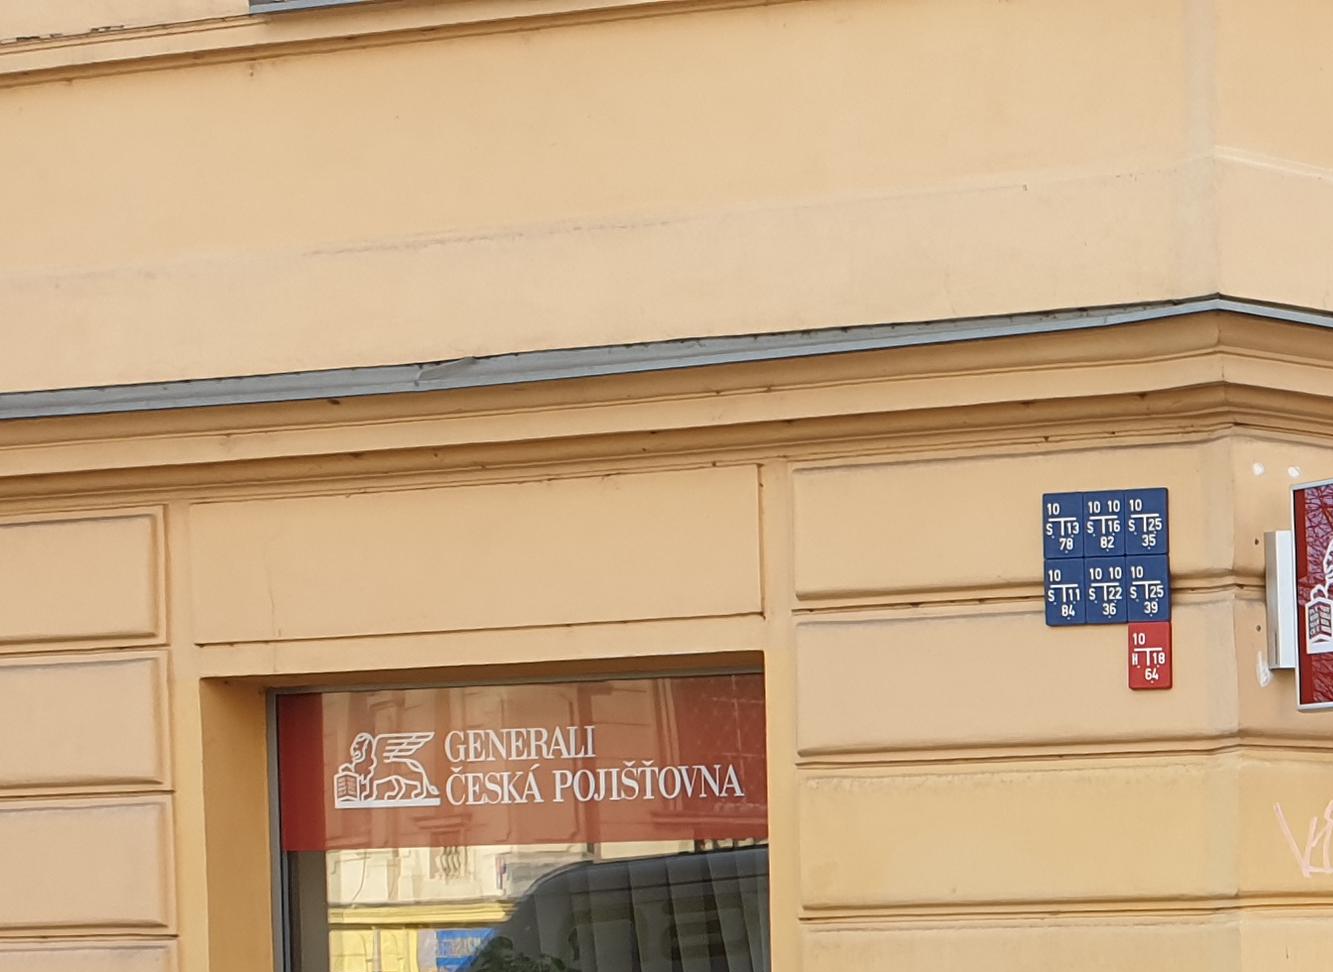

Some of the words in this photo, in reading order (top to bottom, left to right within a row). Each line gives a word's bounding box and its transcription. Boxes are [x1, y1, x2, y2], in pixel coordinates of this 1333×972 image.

[1047, 503, 1060, 515] 10
[1088, 501, 1100, 514] 10
[1108, 500, 1120, 512] 10
[1130, 499, 1142, 511] 10
[1046, 523, 1053, 536] S
[1067, 522, 1080, 534] 13
[1087, 522, 1094, 534] S
[1108, 520, 1120, 533] 16
[1128, 520, 1135, 532] S
[1149, 519, 1162, 531] 25
[1060, 538, 1073, 550] 78
[1101, 536, 1114, 549] 82
[1142, 534, 1156, 546] 35
[1048, 570, 1061, 582] 10
[1089, 568, 1102, 580] 10
[1109, 567, 1122, 579] 10
[1131, 566, 1143, 578] 10
[1048, 590, 1055, 602] S
[1069, 589, 1081, 601] 11
[1089, 588, 1096, 600] S
[1109, 587, 1122, 599] 22
[1130, 586, 1137, 598] S
[1150, 585, 1164, 597] 25
[1062, 605, 1075, 617] 84
[1103, 603, 1116, 615] 36
[1144, 602, 1158, 613] 39
[1133, 633, 1145, 645] 10
[1132, 653, 1138, 665] H
[1153, 652, 1165, 664] 18
[1145, 668, 1158, 680] 64
[444, 726, 596, 763] GENERALI
[446, 764, 542, 805] ČESKÁ
[552, 760, 744, 803] POJIŠŤOVNA
